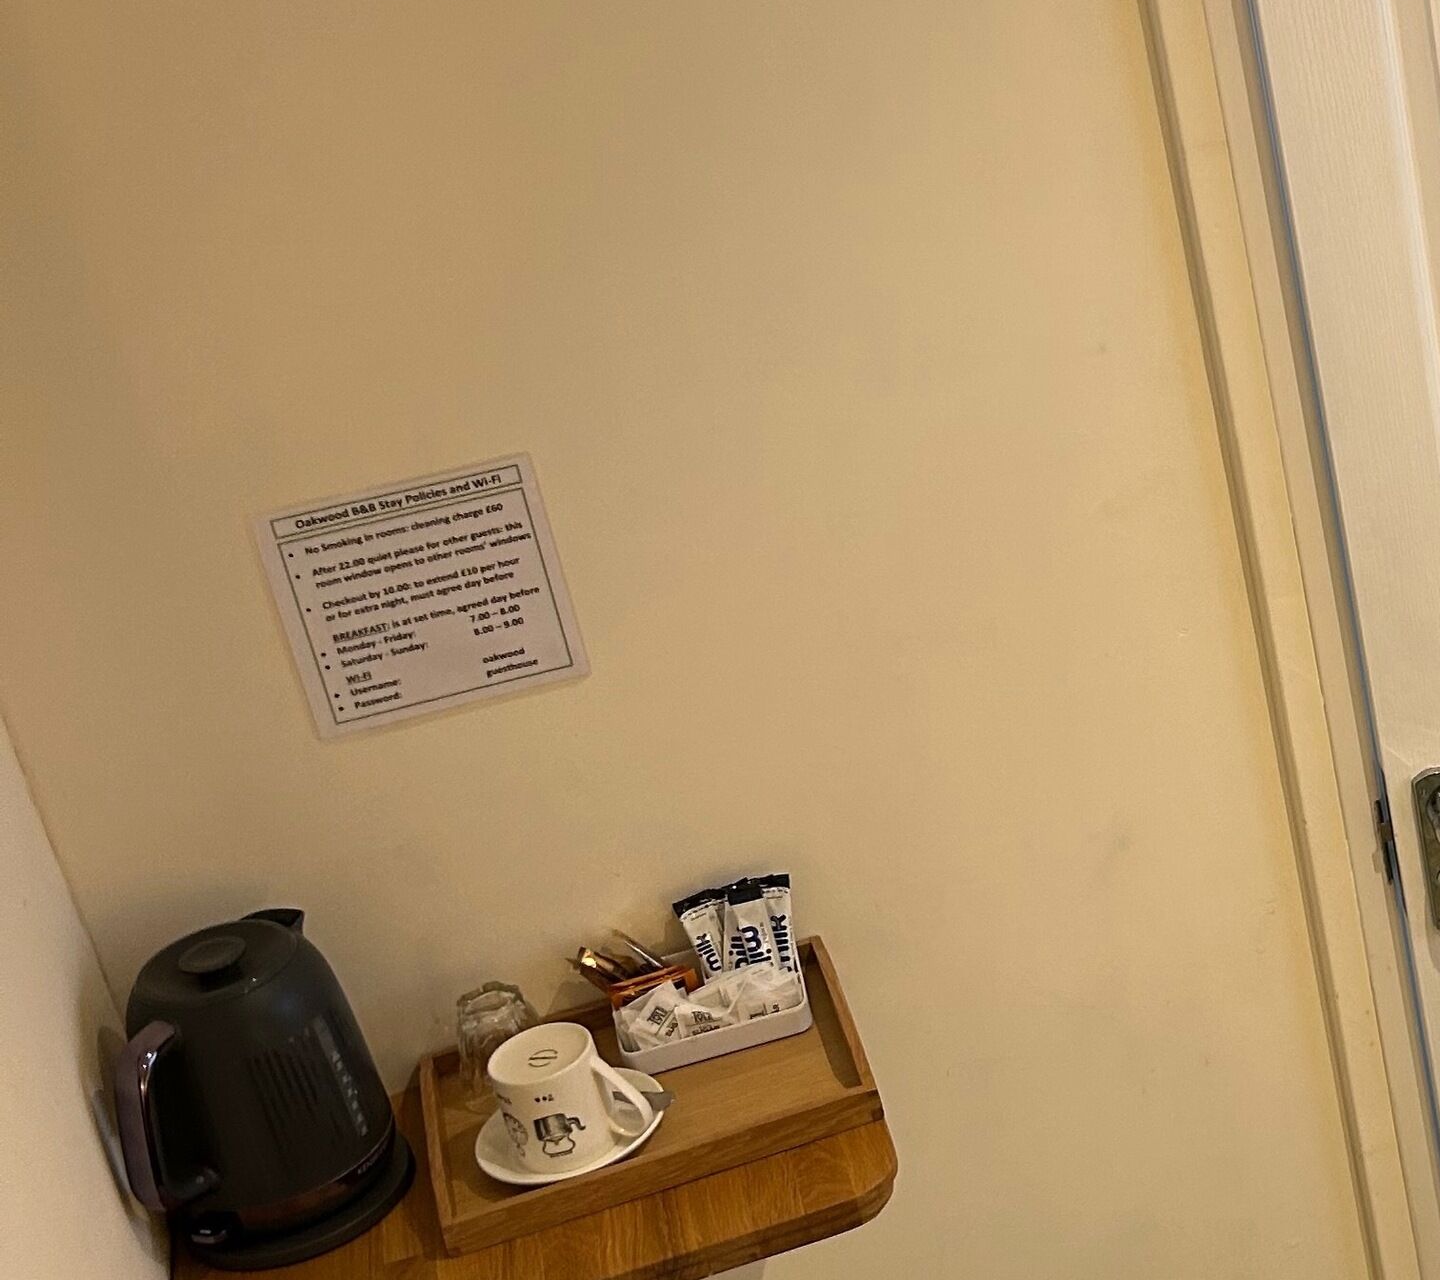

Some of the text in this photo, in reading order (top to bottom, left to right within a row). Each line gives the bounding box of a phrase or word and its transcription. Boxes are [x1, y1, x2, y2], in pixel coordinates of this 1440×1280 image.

[295, 474, 502, 529] Oakwood B&B Stay Policies and Wi-Fi
[304, 547, 320, 555] No
[320, 536, 364, 552] Smoking
[363, 534, 374, 542] in
[375, 526, 409, 539] rooms:
[411, 516, 451, 531] cleaning
[452, 509, 484, 522] charge
[312, 565, 336, 577] After
[338, 557, 366, 571] 22.00
[367, 552, 392, 565] quiet
[393, 545, 424, 559] please
[426, 541, 440, 550] for
[442, 535, 468, 546] other
[504, 522, 523, 532] this
[315, 577, 343, 589] room
[343, 568, 382, 582] window
[384, 561, 413, 573] opens
[413, 558, 425, 566] to
[427, 551, 452, 563] other
[489, 533, 532, 547] windows
[322, 593, 368, 610] Checkout
[368, 591, 381, 599] by
[426, 570, 459, 585] extend
[461, 566, 478, 577] £10
[480, 563, 496, 574] per
[497, 558, 520, 568] hour
[325, 572, 514, 622] or for extra night, must agree day before
[392, 620, 401, 629] is
[402, 617, 412, 626] at
[413, 613, 429, 623] set
[457, 598, 489, 613] agreed
[490, 595, 507, 604] day
[508, 587, 540, 600] before
[336, 641, 376, 655] Monday
[469, 611, 491, 623] 7.00
[341, 653, 383, 668] Saturday
[482, 647, 525, 664] oakwood
[486, 659, 538, 679] guesthouse
[695, 933, 722, 971] milk
[741, 926, 773, 965] mil
